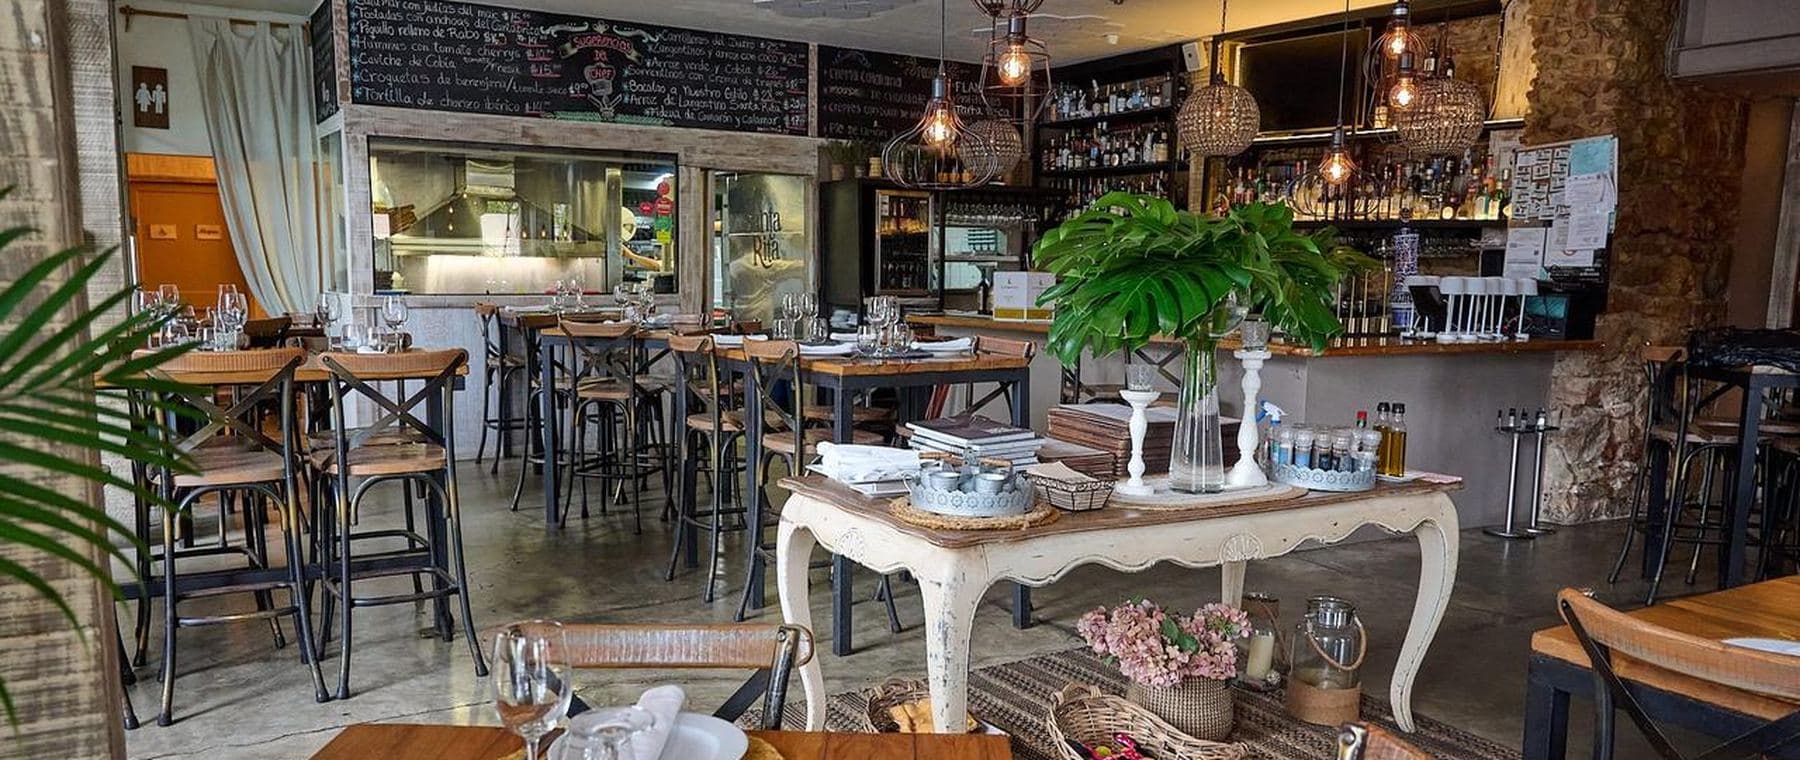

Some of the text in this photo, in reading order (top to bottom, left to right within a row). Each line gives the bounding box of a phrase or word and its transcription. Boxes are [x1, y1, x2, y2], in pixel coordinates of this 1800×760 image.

[402, 2, 421, 11] con
[405, 12, 424, 22] con
[432, 26, 446, 38] de
[447, 27, 481, 40] Rabo
[411, 42, 430, 52] con
[359, 69, 431, 87] Croquetas
[437, 71, 454, 86] de
[361, 86, 414, 104] Tortilla
[417, 91, 435, 106] de
[753, 235, 780, 269] Rita
